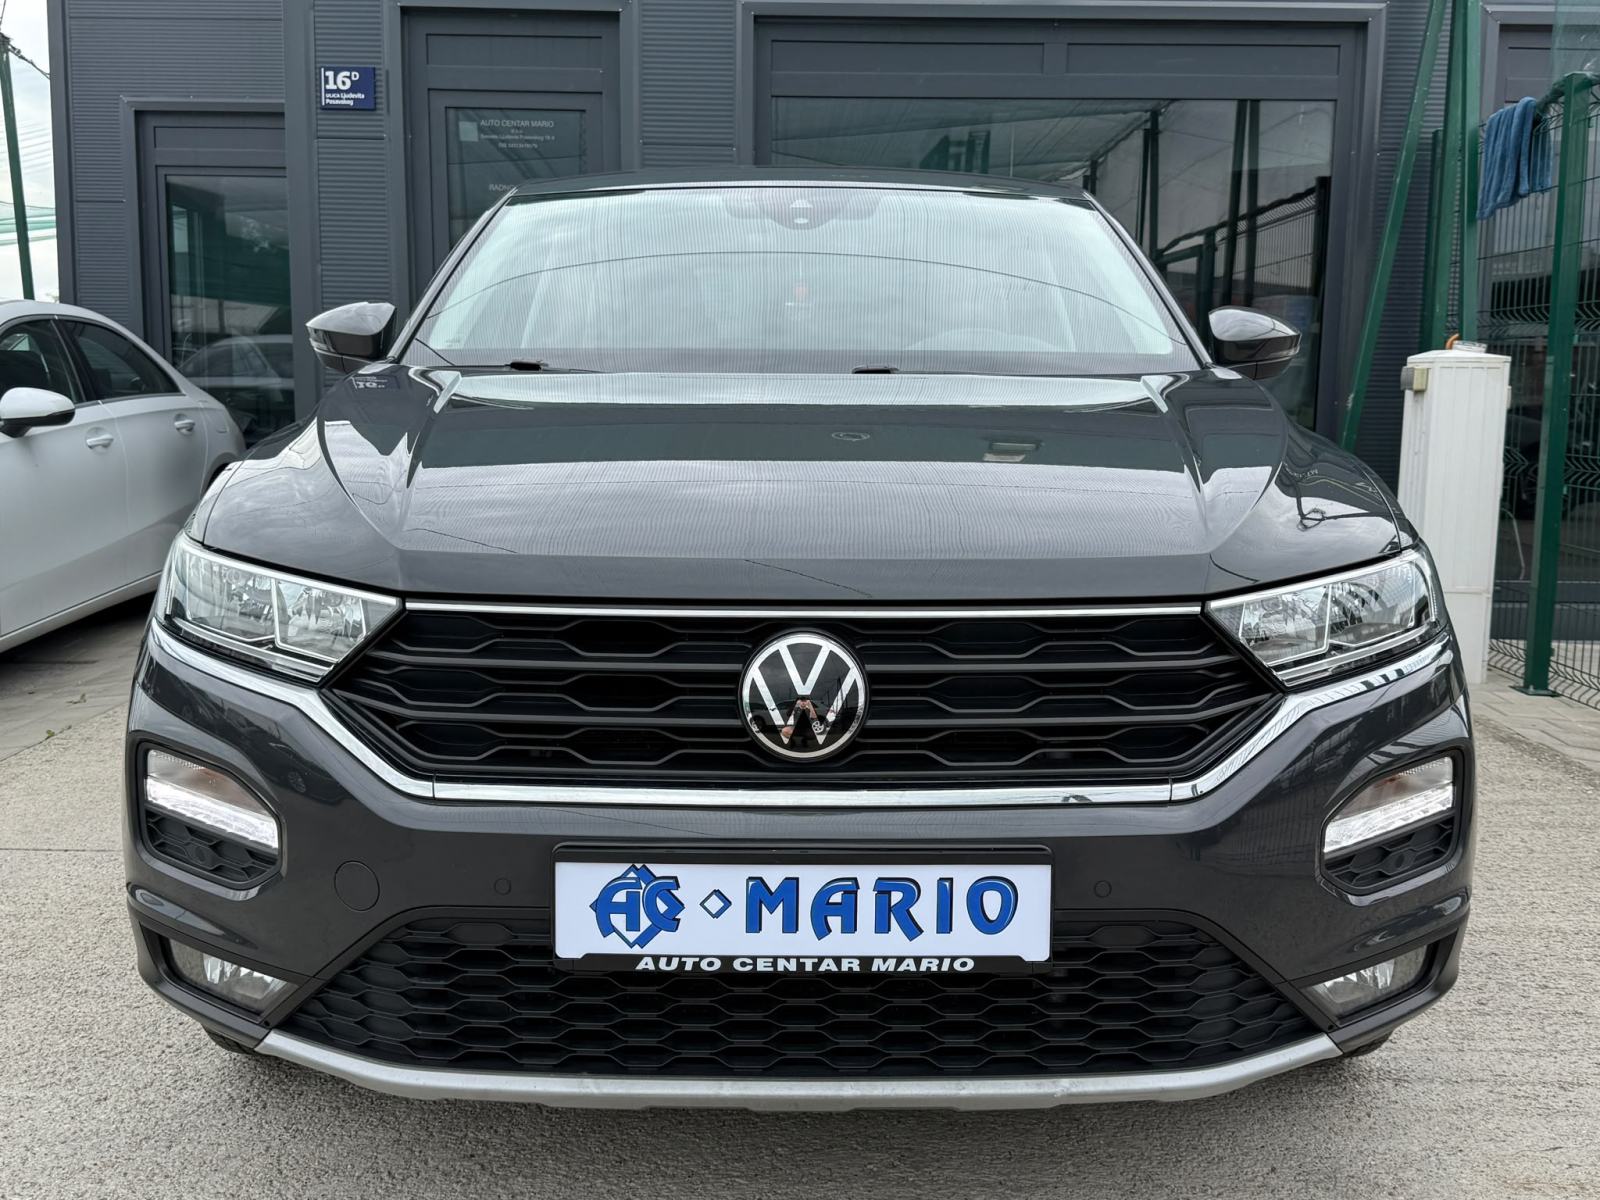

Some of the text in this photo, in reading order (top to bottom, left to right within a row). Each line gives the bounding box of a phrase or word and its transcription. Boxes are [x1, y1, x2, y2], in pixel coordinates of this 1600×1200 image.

[480, 119, 554, 128] AUTO CENTAR MARIO
[745, 876, 1019, 942] MARIO
[635, 957, 976, 972] AUTO CENTAR MARIO
